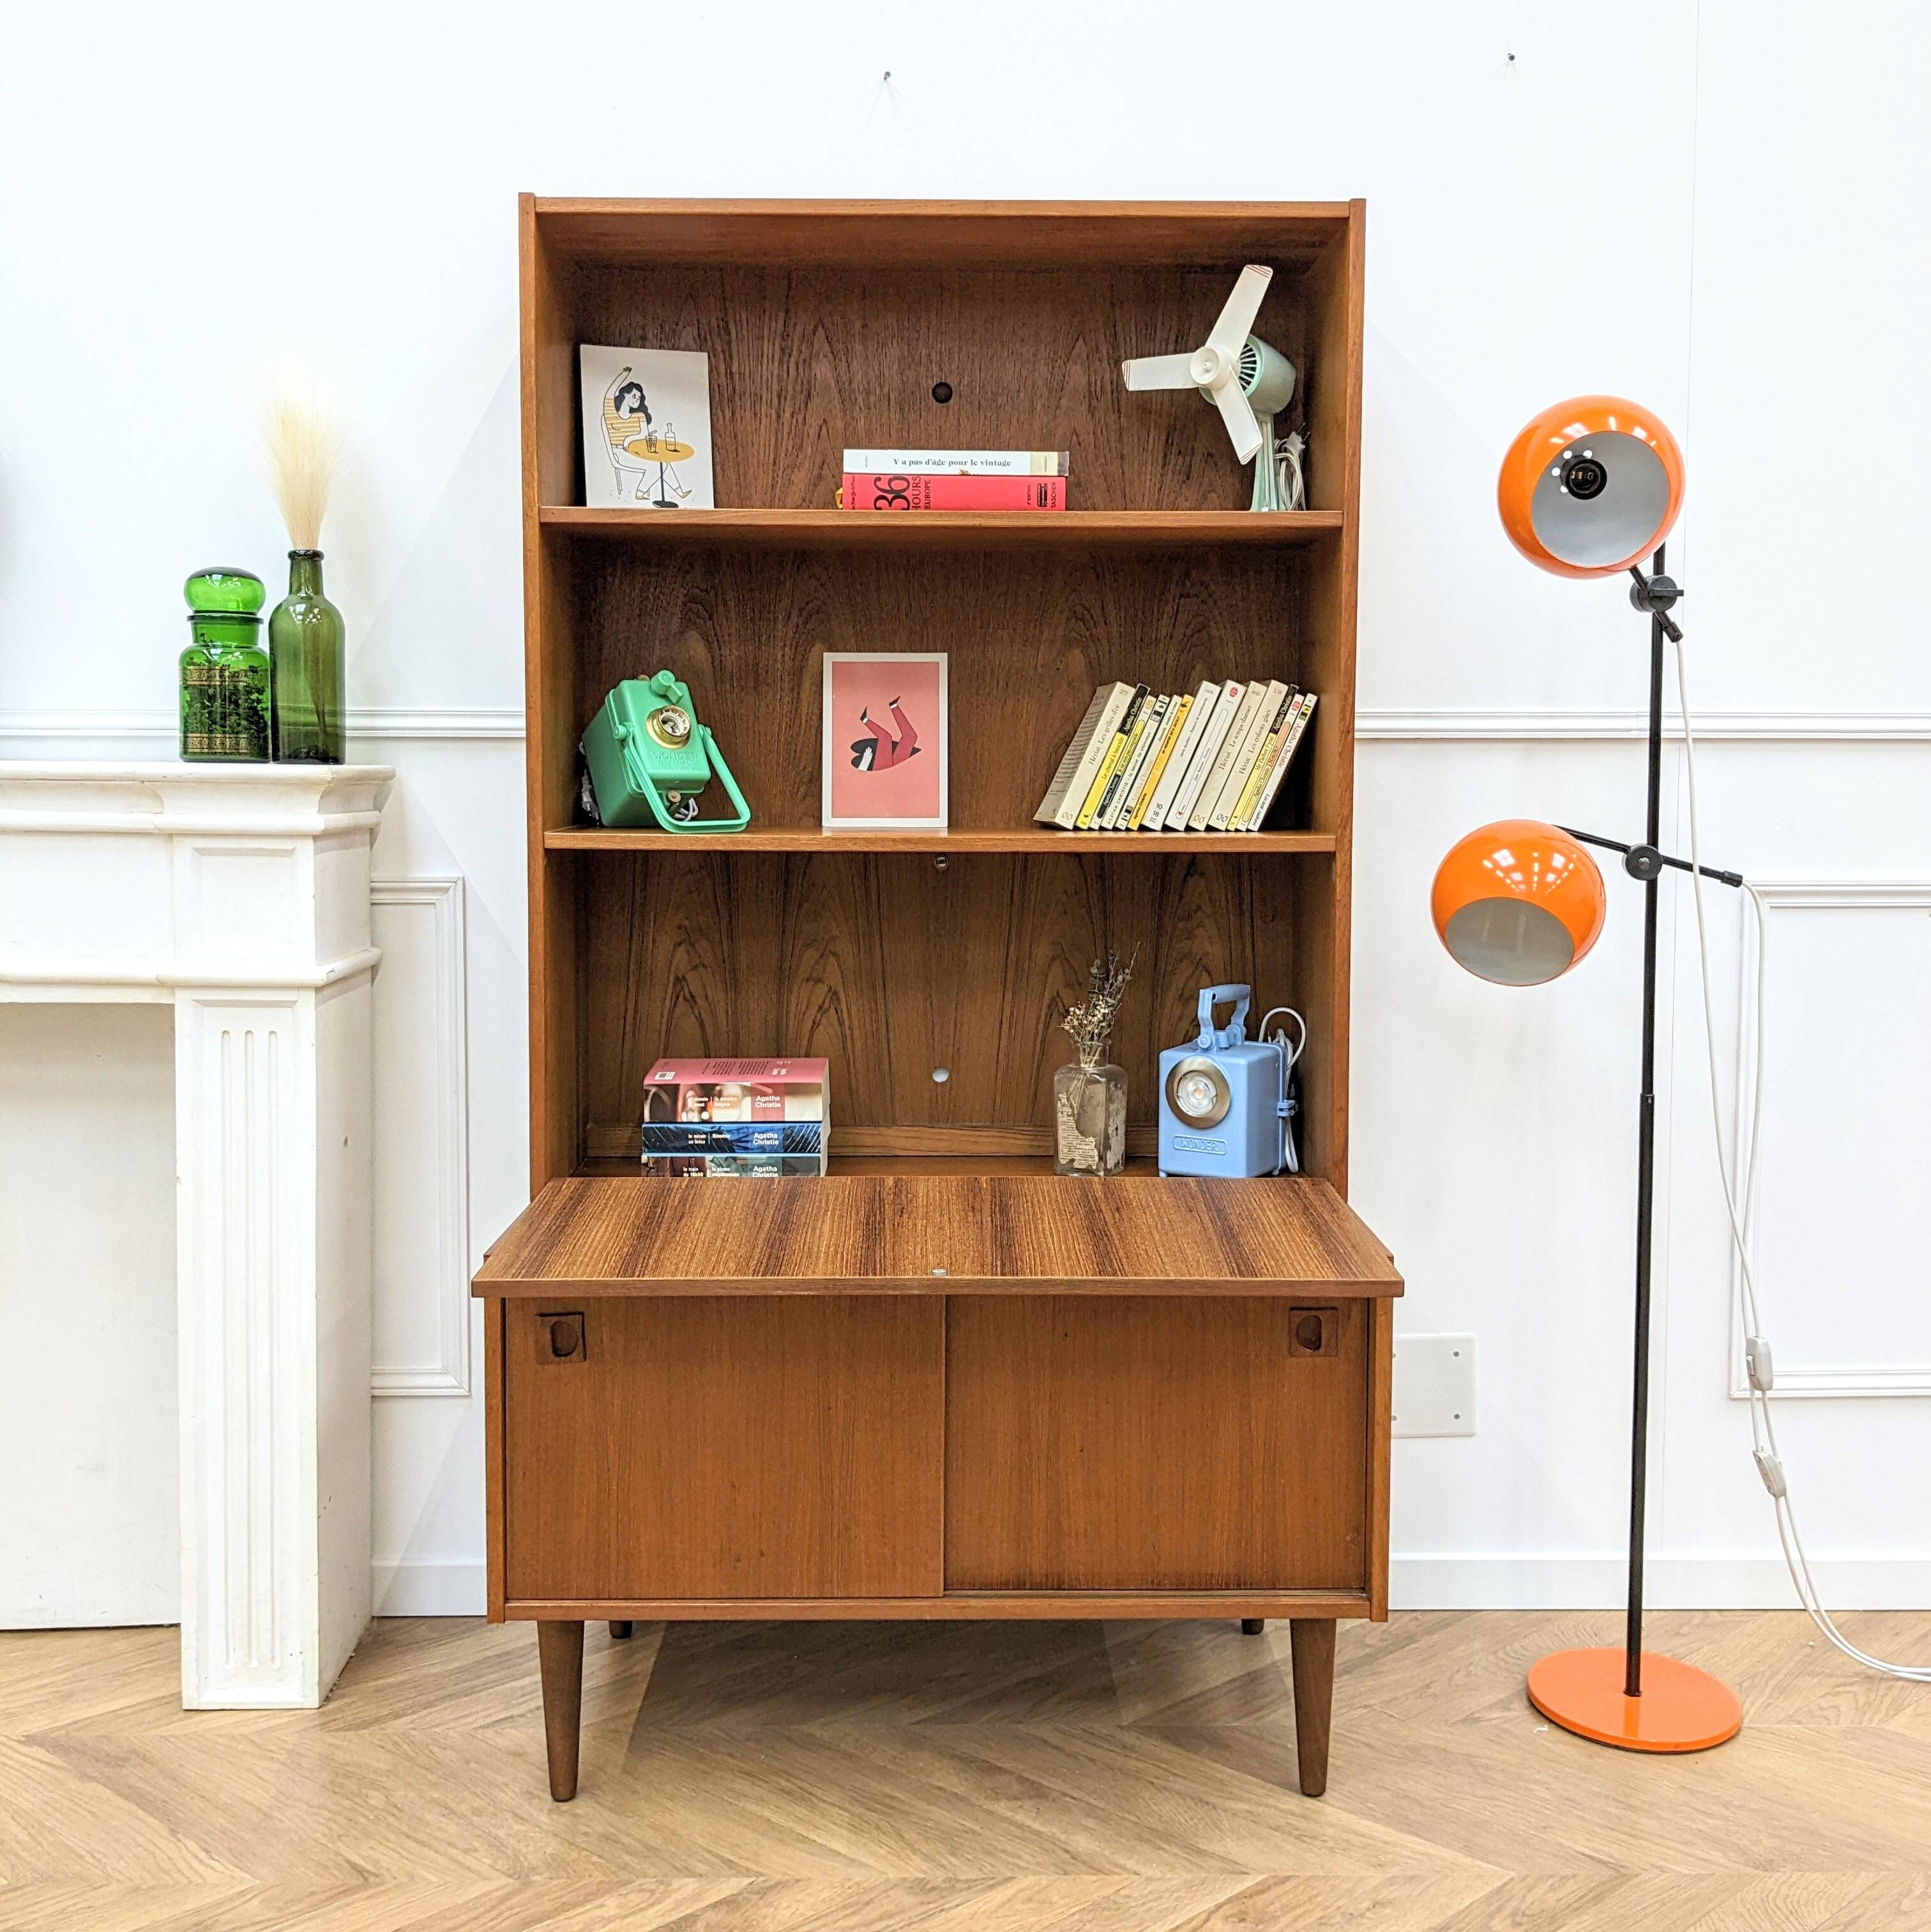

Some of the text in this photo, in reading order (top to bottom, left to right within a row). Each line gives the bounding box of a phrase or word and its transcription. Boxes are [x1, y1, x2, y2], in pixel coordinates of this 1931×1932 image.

[925, 459, 946, 467] d'âge
[874, 476, 910, 510] 36
[1097, 732, 1107, 744] Les
[1102, 715, 1116, 733] grilles
[1110, 703, 1120, 715] d'or
[1122, 696, 1142, 732] Agatha Christie
[1271, 694, 1292, 731] Agatha Christie
[650, 751, 698, 760] WONDER
[1103, 757, 1114, 773] cheval
[1112, 736, 1124, 754] bascule
[1228, 738, 1237, 747] Le
[1248, 742, 1257, 753] Les
[1254, 734, 1275, 771] Mr Parker Pyne
[1130, 758, 1139, 772] secret
[1102, 775, 1119, 806] Agatha Christie
[1107, 781, 1128, 825] AGATHA CHRISTIE
[1180, 1137, 1218, 1152] WONDER
